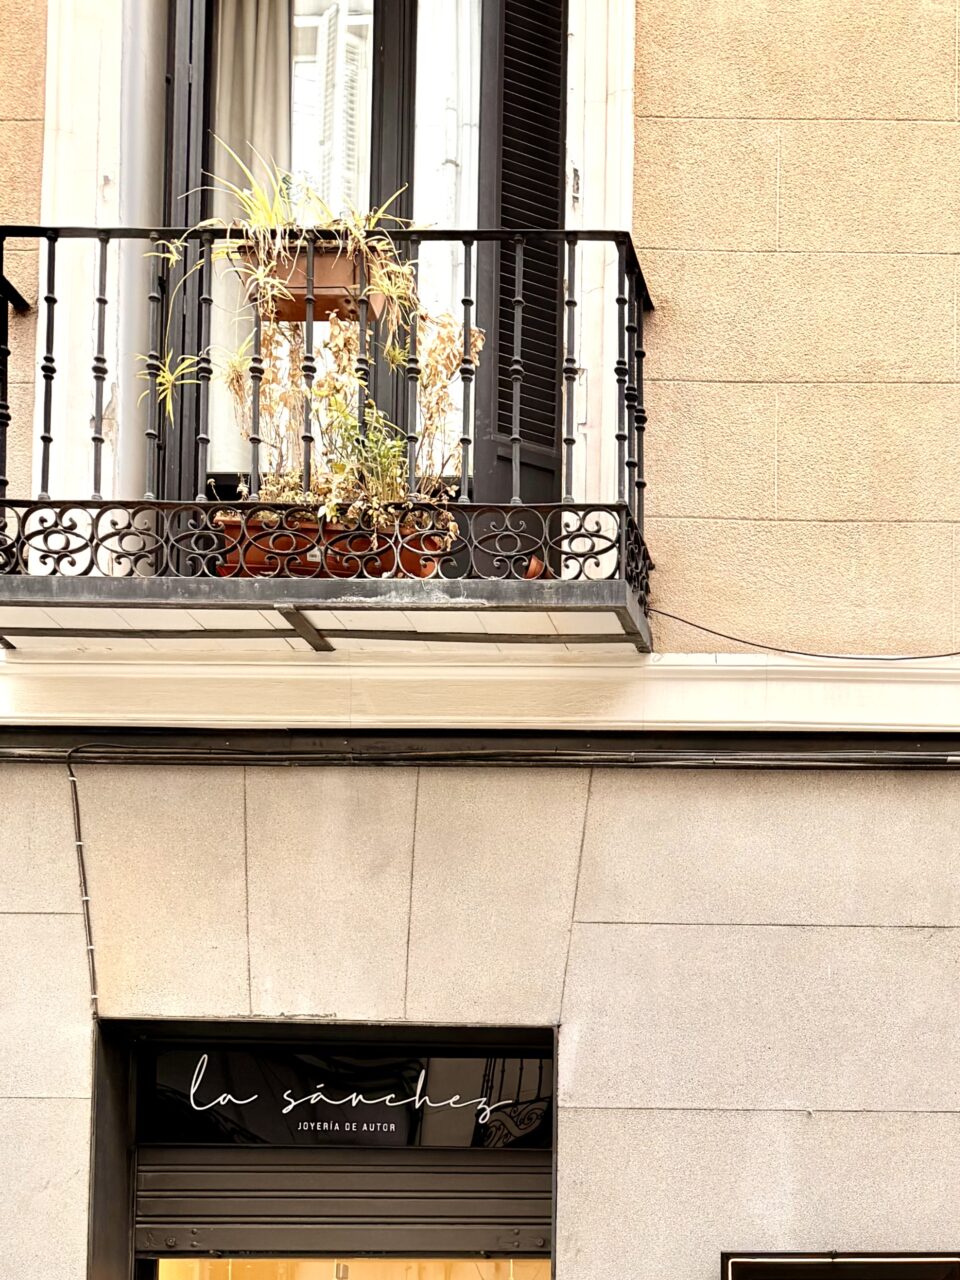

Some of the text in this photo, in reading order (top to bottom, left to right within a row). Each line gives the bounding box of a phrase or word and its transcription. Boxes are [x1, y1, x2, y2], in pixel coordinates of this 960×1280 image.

[189, 1053, 513, 1124] la sánchez
[297, 1121, 396, 1132] JOYERÍA DE AUTOR
